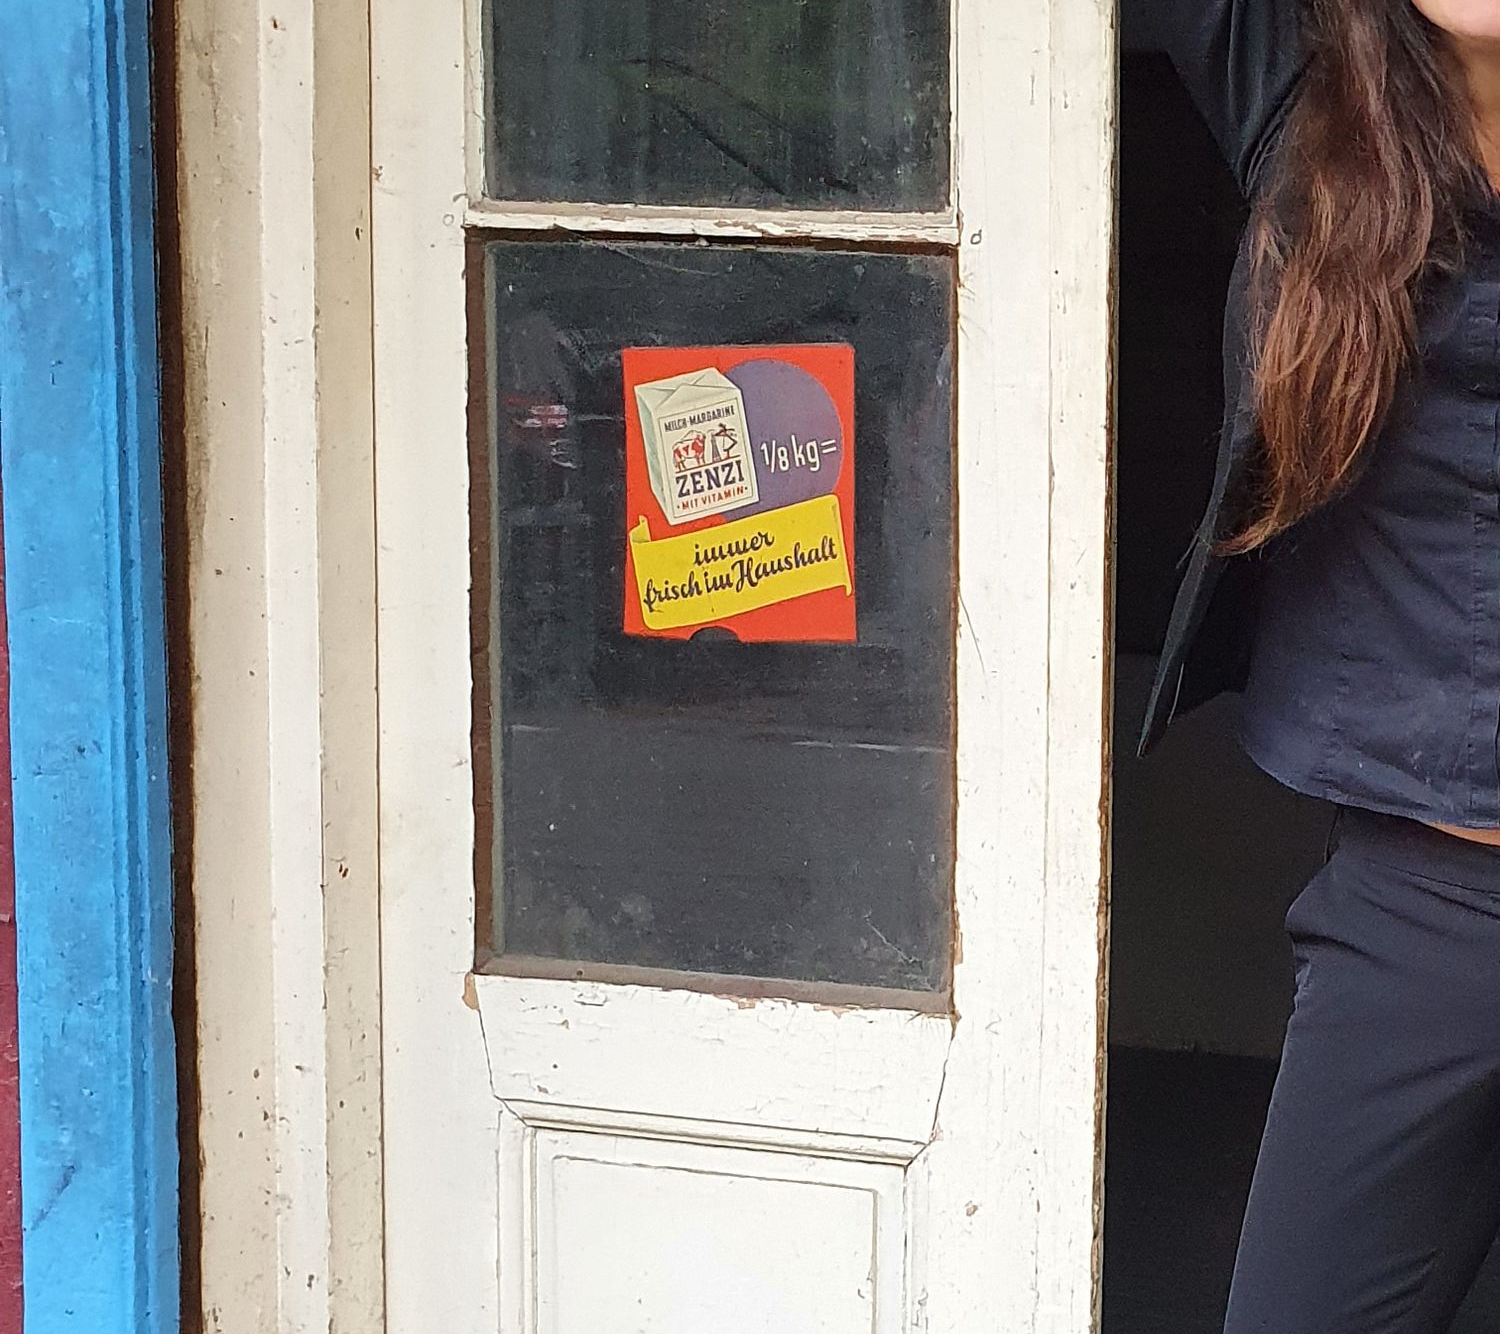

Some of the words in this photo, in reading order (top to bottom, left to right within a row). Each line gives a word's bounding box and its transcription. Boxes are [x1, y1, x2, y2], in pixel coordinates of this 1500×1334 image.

[675, 460, 744, 498] ZENZI
[701, 485, 744, 506] VITAMIN
[693, 531, 775, 566] immer
[643, 572, 703, 613] frisch
[704, 573, 735, 593] im
[731, 538, 838, 593] Haushalt
